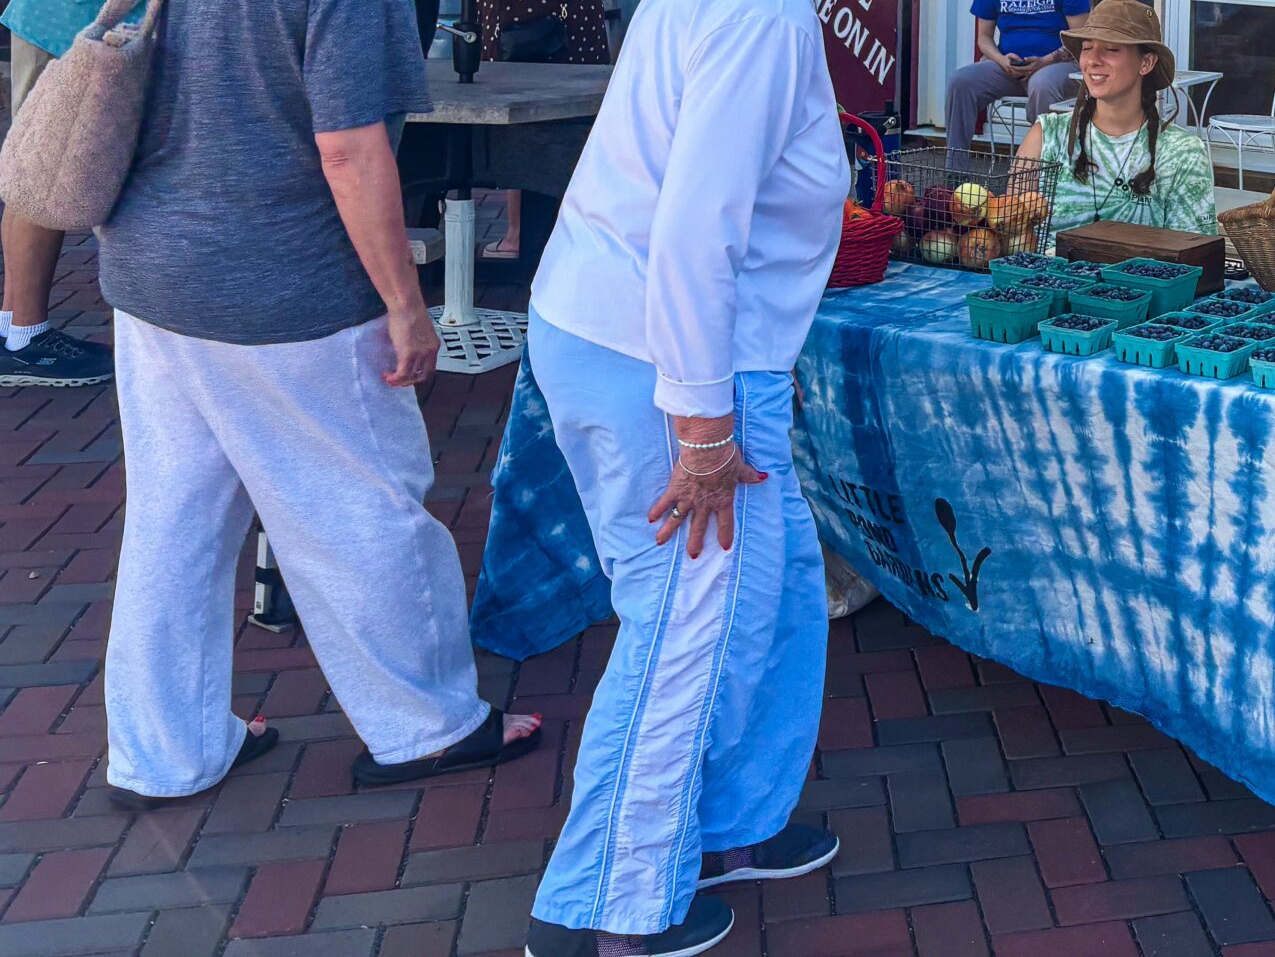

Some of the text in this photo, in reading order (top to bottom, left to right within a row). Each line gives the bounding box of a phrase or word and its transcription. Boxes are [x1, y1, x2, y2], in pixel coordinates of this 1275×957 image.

[833, 6, 896, 86] ON IN
[828, 474, 905, 524] LITTLE
